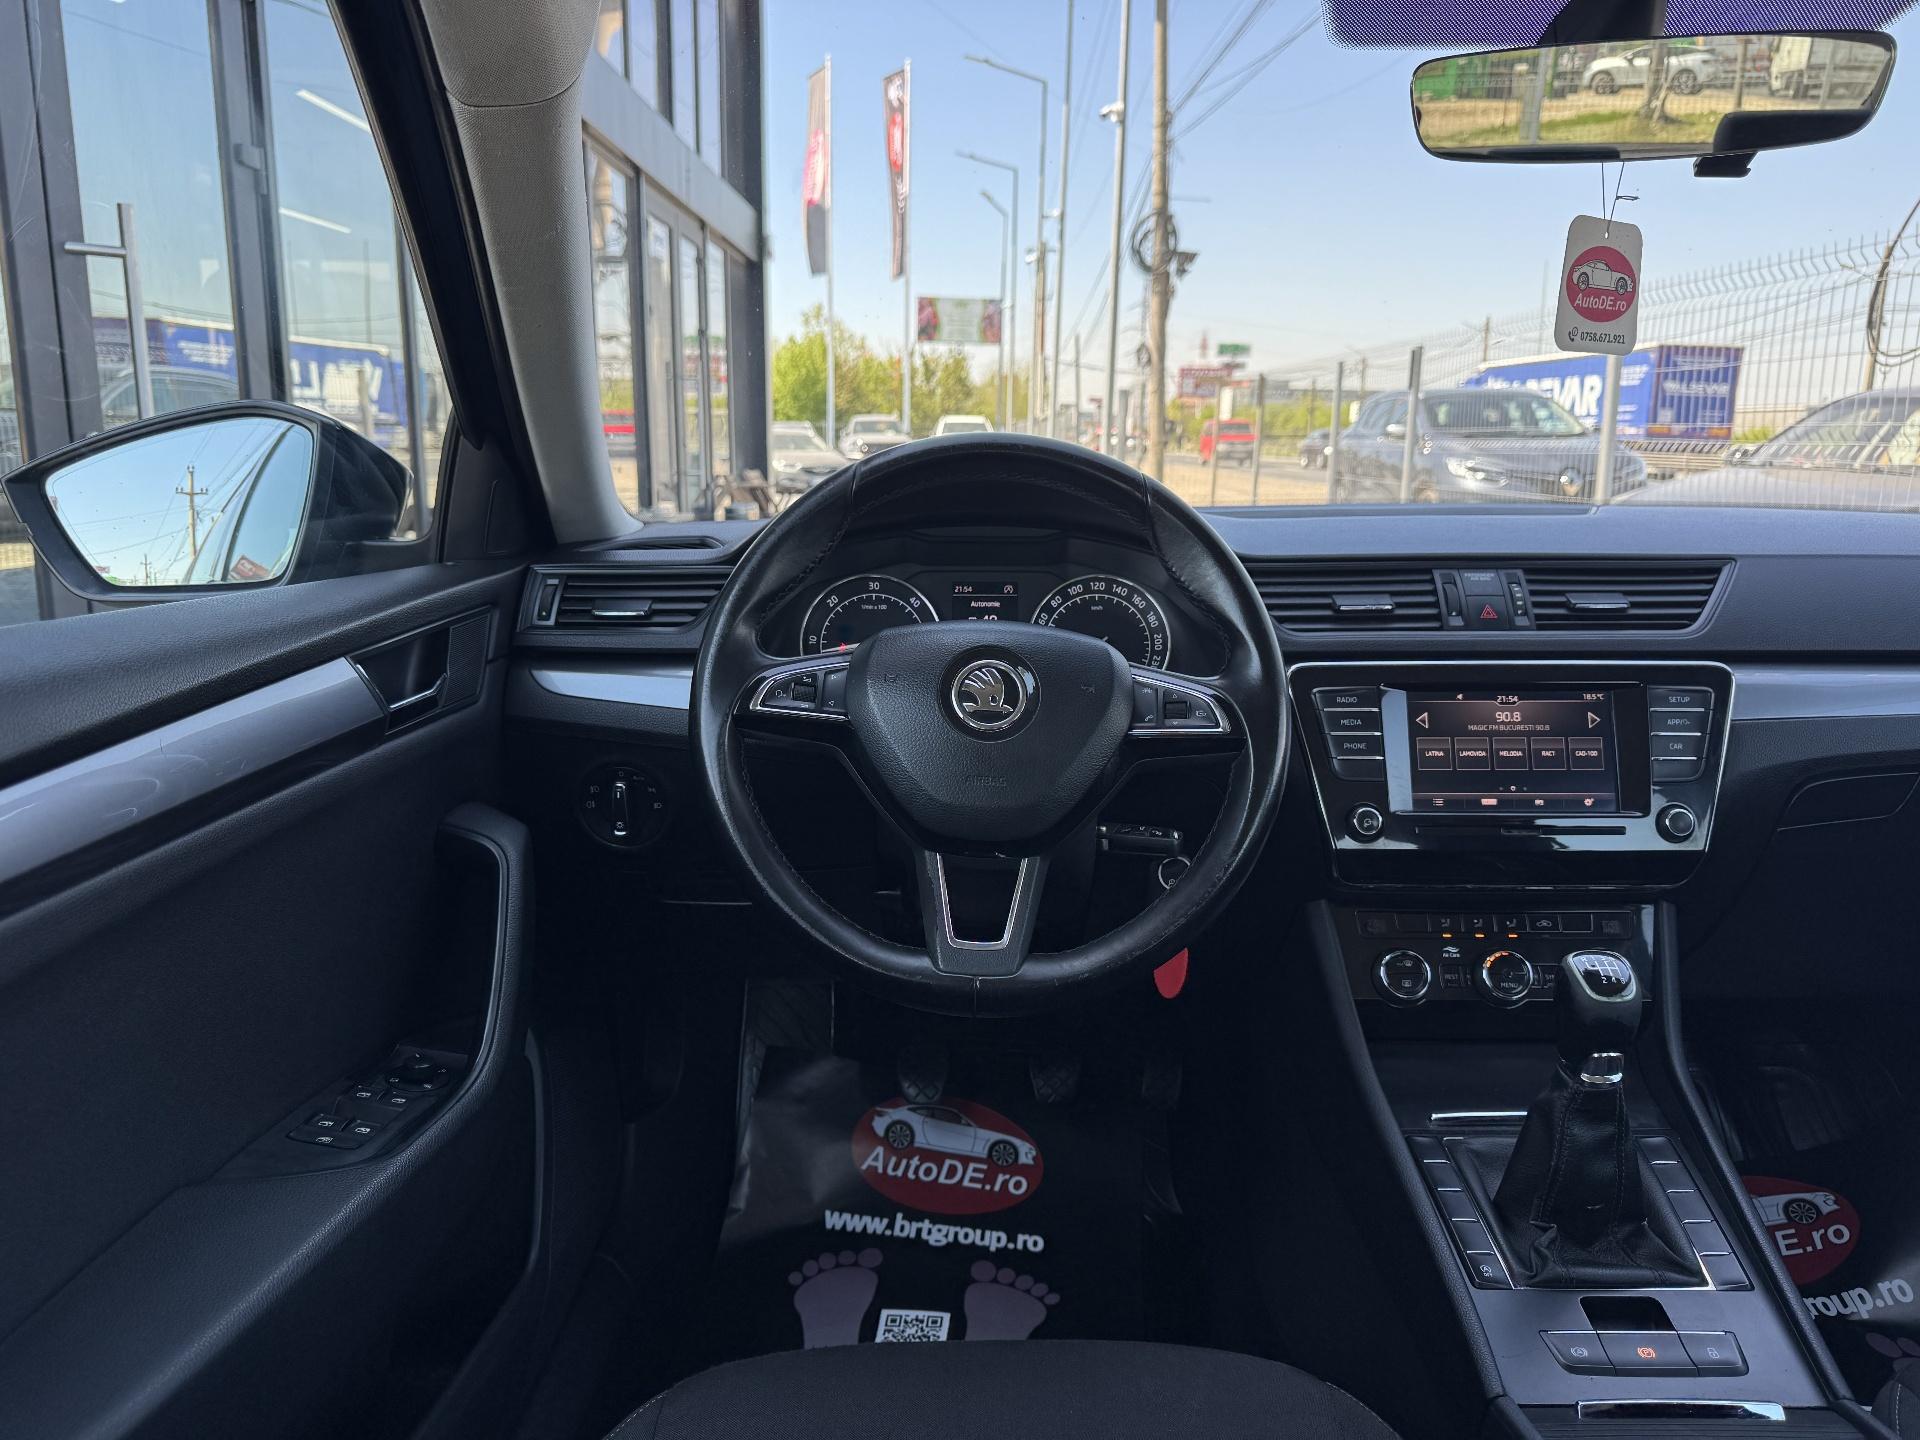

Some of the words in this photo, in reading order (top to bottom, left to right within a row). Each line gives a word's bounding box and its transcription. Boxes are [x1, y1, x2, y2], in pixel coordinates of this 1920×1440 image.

[1574, 293, 1627, 311] AutoDE.ro
[1580, 331, 1625, 344] 0758.671.921
[808, 635, 817, 645] 10
[826, 595, 839, 607] 20
[868, 582, 880, 590] 30
[909, 597, 921, 608] 40
[1038, 612, 1049, 626] 60
[1050, 595, 1062, 608] 80
[1067, 584, 1084, 596] 100
[1090, 582, 1106, 590] 120
[1112, 584, 1128, 597] 140
[1131, 594, 1146, 609] 160
[1146, 611, 1159, 628] 180
[1153, 633, 1163, 651] 200
[1497, 695, 1518, 703] 21:54
[1496, 712, 1520, 722] 90.8
[1602, 976, 1608, 984] 2
[860, 1145, 1028, 1196] AutoDE.ro
[824, 1209, 1045, 1253] www.brtgroup.ro
[1774, 1224, 1850, 1256] E.ro
[1802, 1279, 1914, 1320] roup.ro
